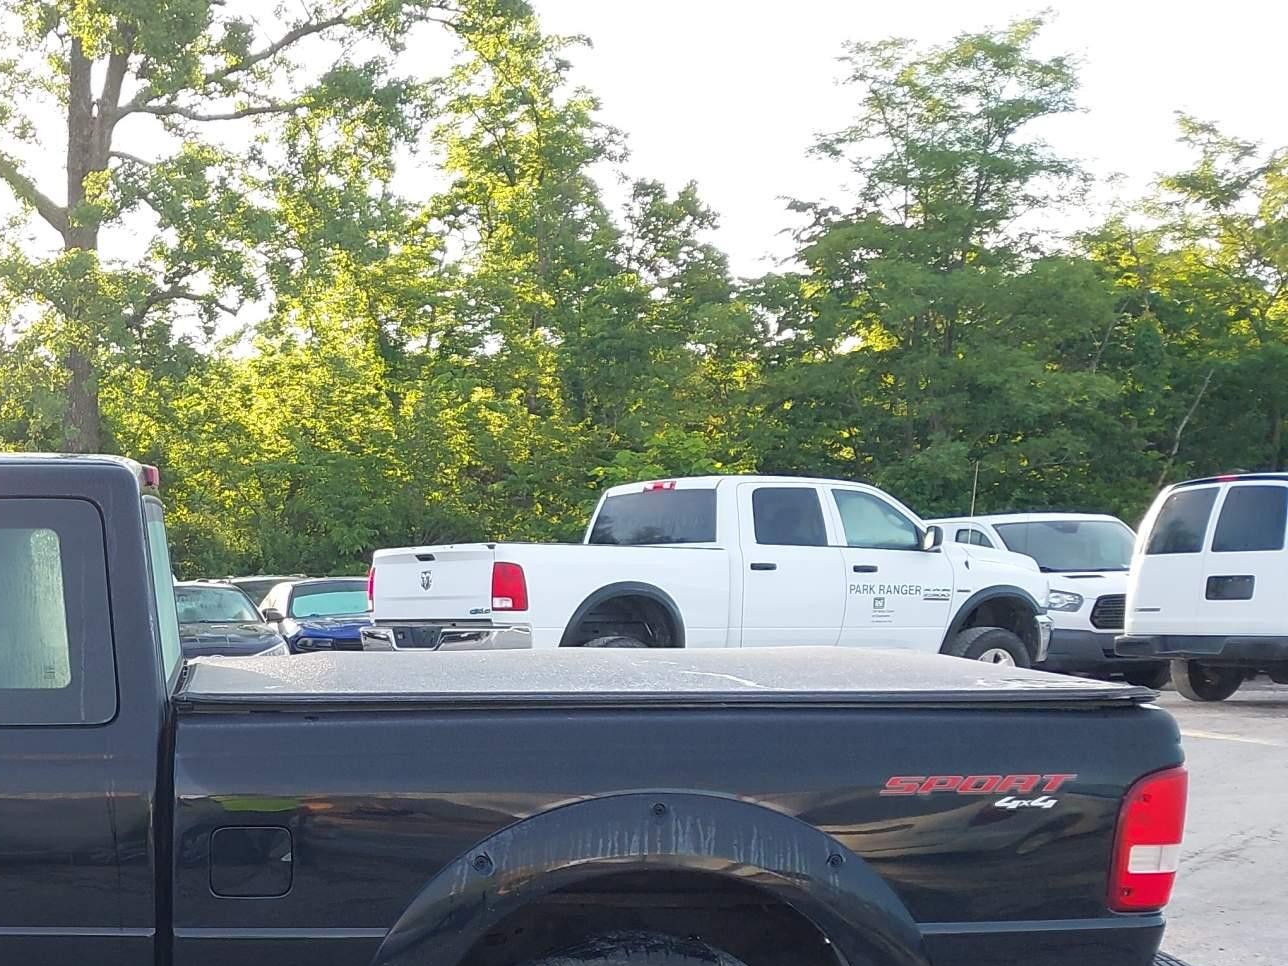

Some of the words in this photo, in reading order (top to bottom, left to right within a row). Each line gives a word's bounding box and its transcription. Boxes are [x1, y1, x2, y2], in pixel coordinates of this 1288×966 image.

[849, 584, 876, 595] PARK
[878, 584, 922, 596] RANGER
[879, 773, 1079, 797] SPORT
[994, 795, 1060, 810] 4x4
